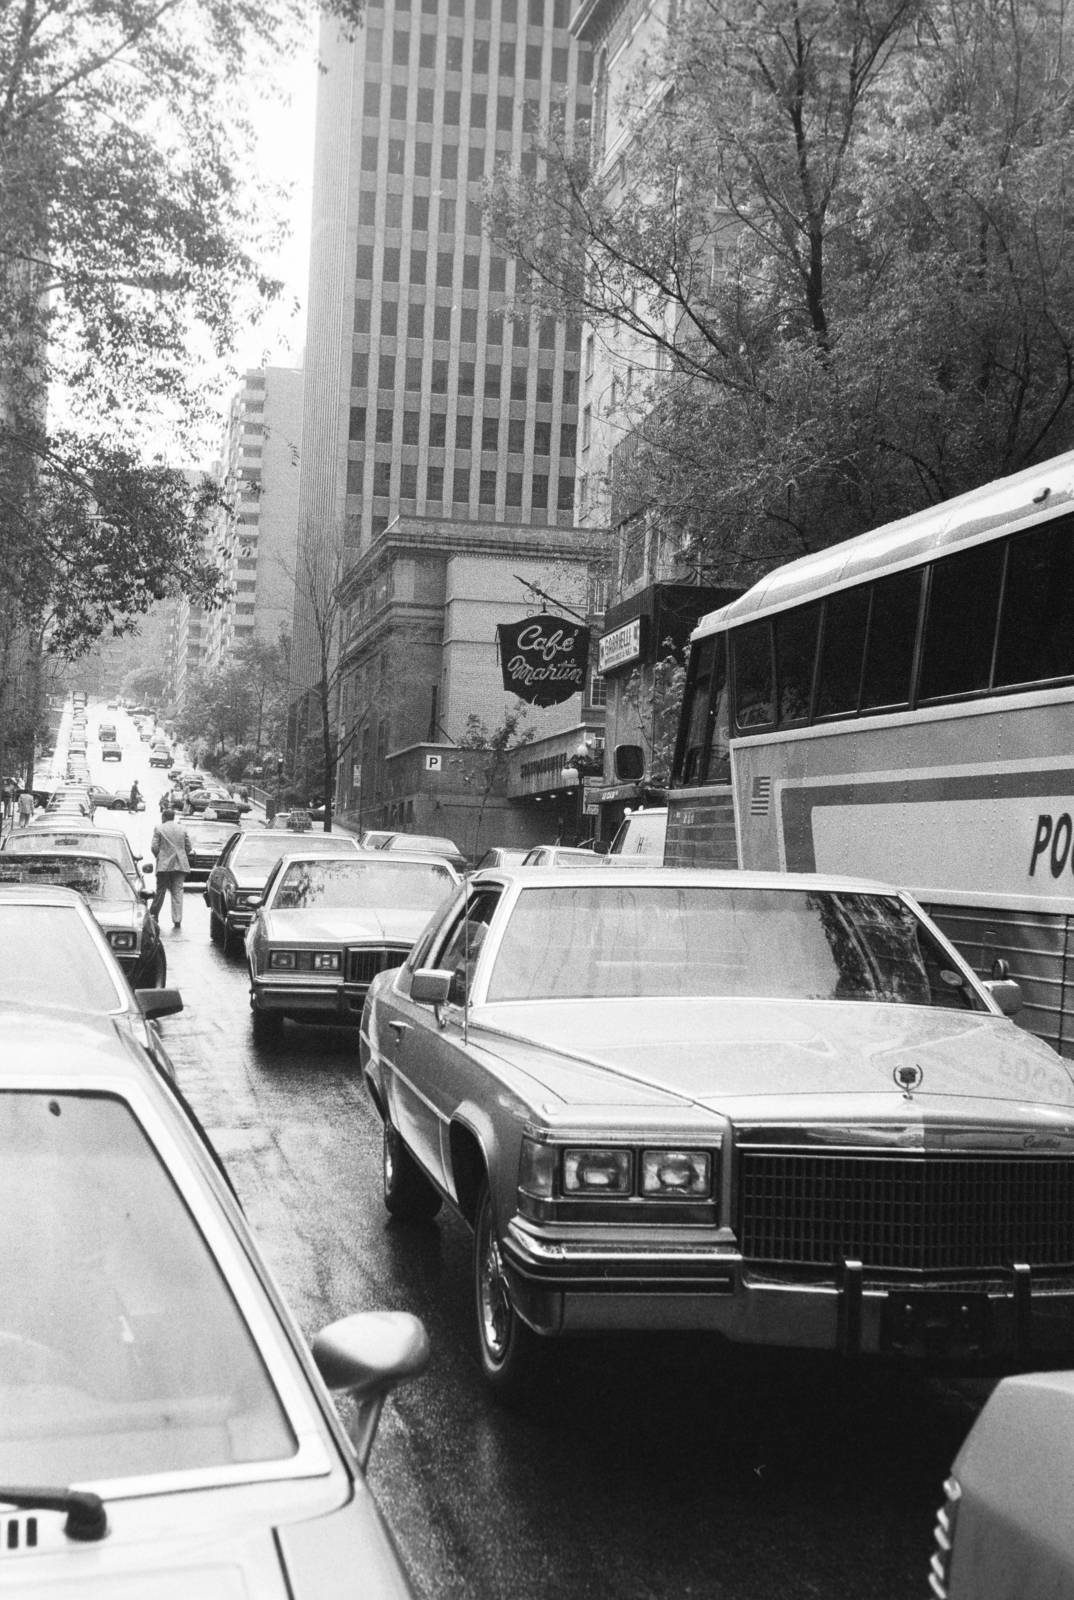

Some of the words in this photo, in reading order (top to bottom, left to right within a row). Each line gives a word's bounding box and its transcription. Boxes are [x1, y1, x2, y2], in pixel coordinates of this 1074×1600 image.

[517, 625, 579, 660] Café
[507, 655, 583, 686] Martin
[429, 757, 439, 768] P
[1029, 812, 1074, 879] PO
